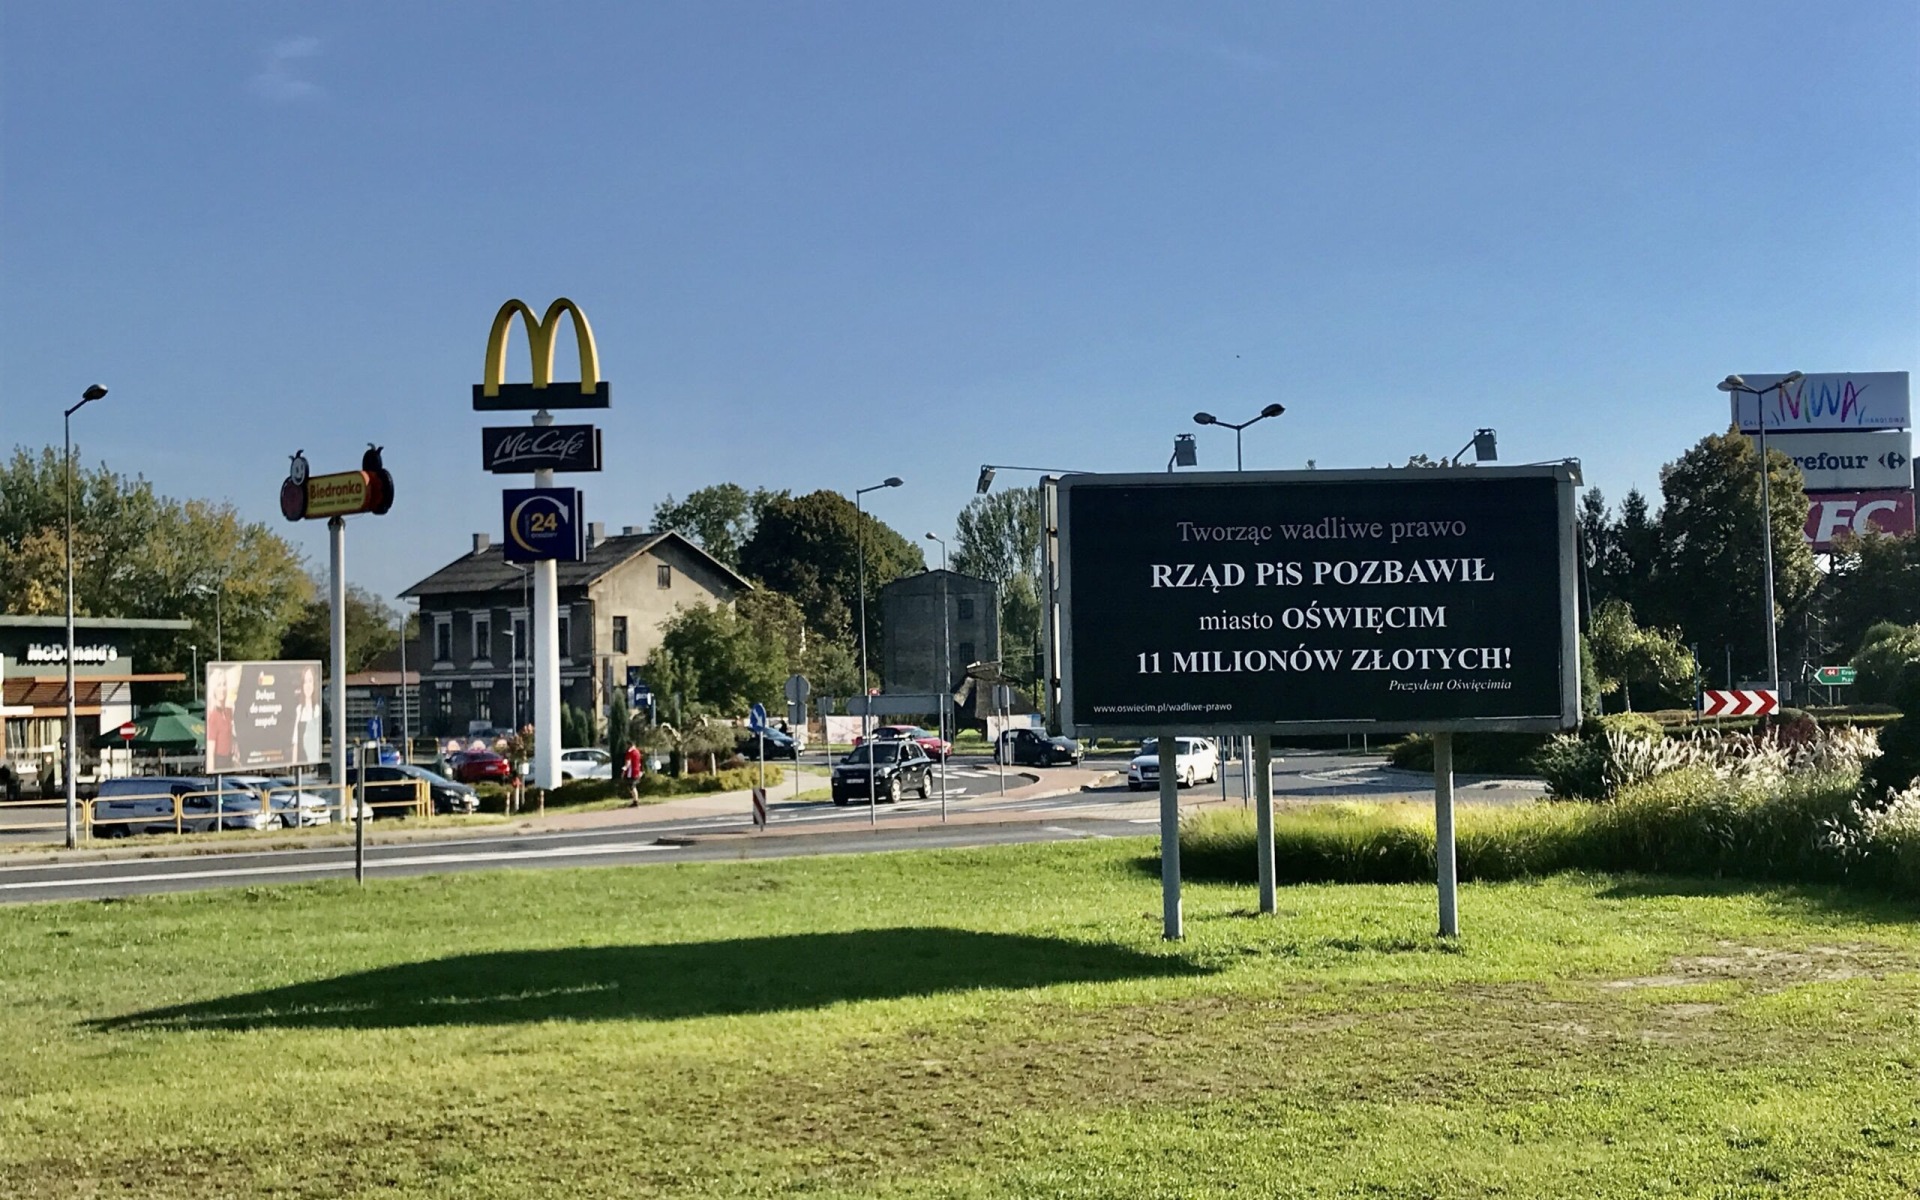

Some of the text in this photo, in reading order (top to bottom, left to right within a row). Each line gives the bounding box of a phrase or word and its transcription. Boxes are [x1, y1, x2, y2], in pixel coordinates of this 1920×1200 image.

[1777, 378, 1870, 423] NIWA
[492, 429, 585, 463] McCafé
[1793, 452, 1869, 470] refour
[310, 480, 362, 500] Biedronka
[531, 512, 558, 532] 24
[1176, 516, 1466, 546] Tworząc wadliwe prawo
[1150, 557, 1495, 594] RZĄD PiS POZBAWIŁ
[1199, 600, 1447, 634] miasto OŚWIĘCIM
[1137, 643, 1512, 673] 11 MILIONÓW ZŁOTYCH!
[1388, 677, 1512, 693] Prezydent Oświęcimia
[1093, 702, 1232, 714] www.oswiecim.pl/wadliwe-prawo
